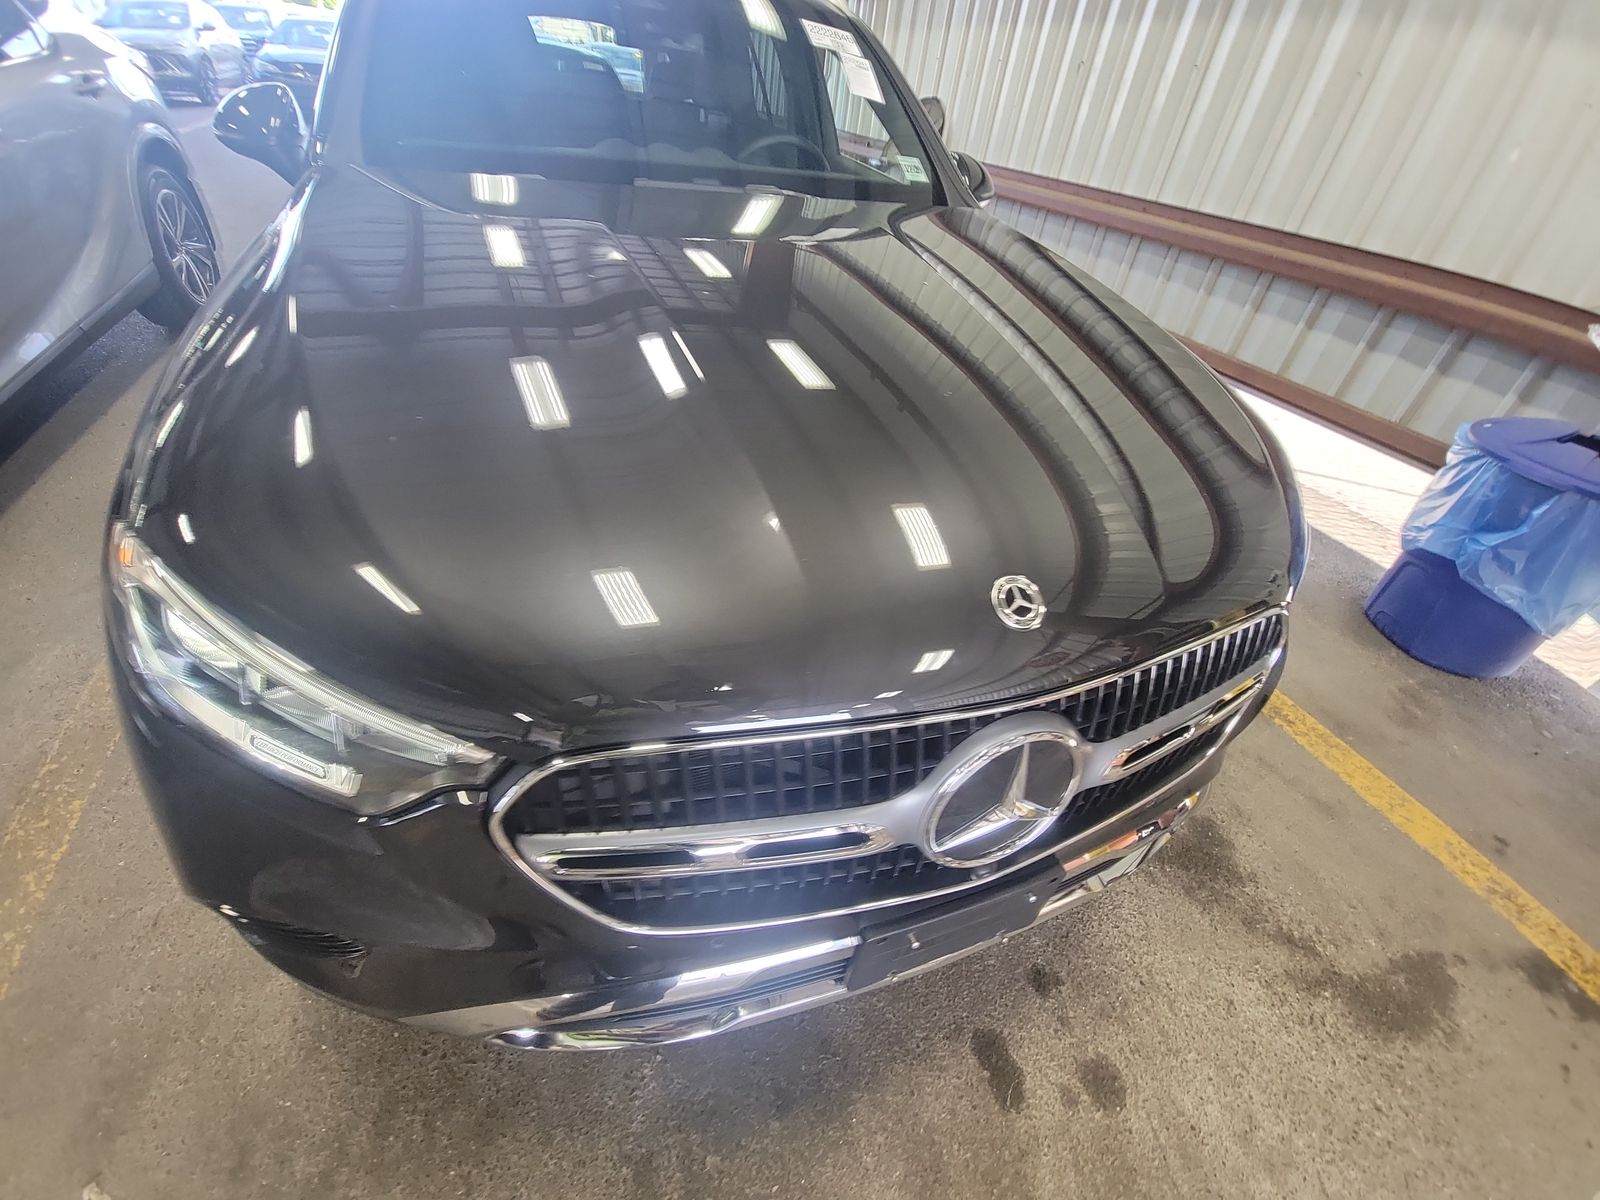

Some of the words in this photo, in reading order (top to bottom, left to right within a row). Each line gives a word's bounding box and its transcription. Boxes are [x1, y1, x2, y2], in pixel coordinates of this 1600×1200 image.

[256, 740, 267, 749] LED
[266, 745, 282, 755] HIGH
[281, 751, 320, 773] PERFORMANCE
